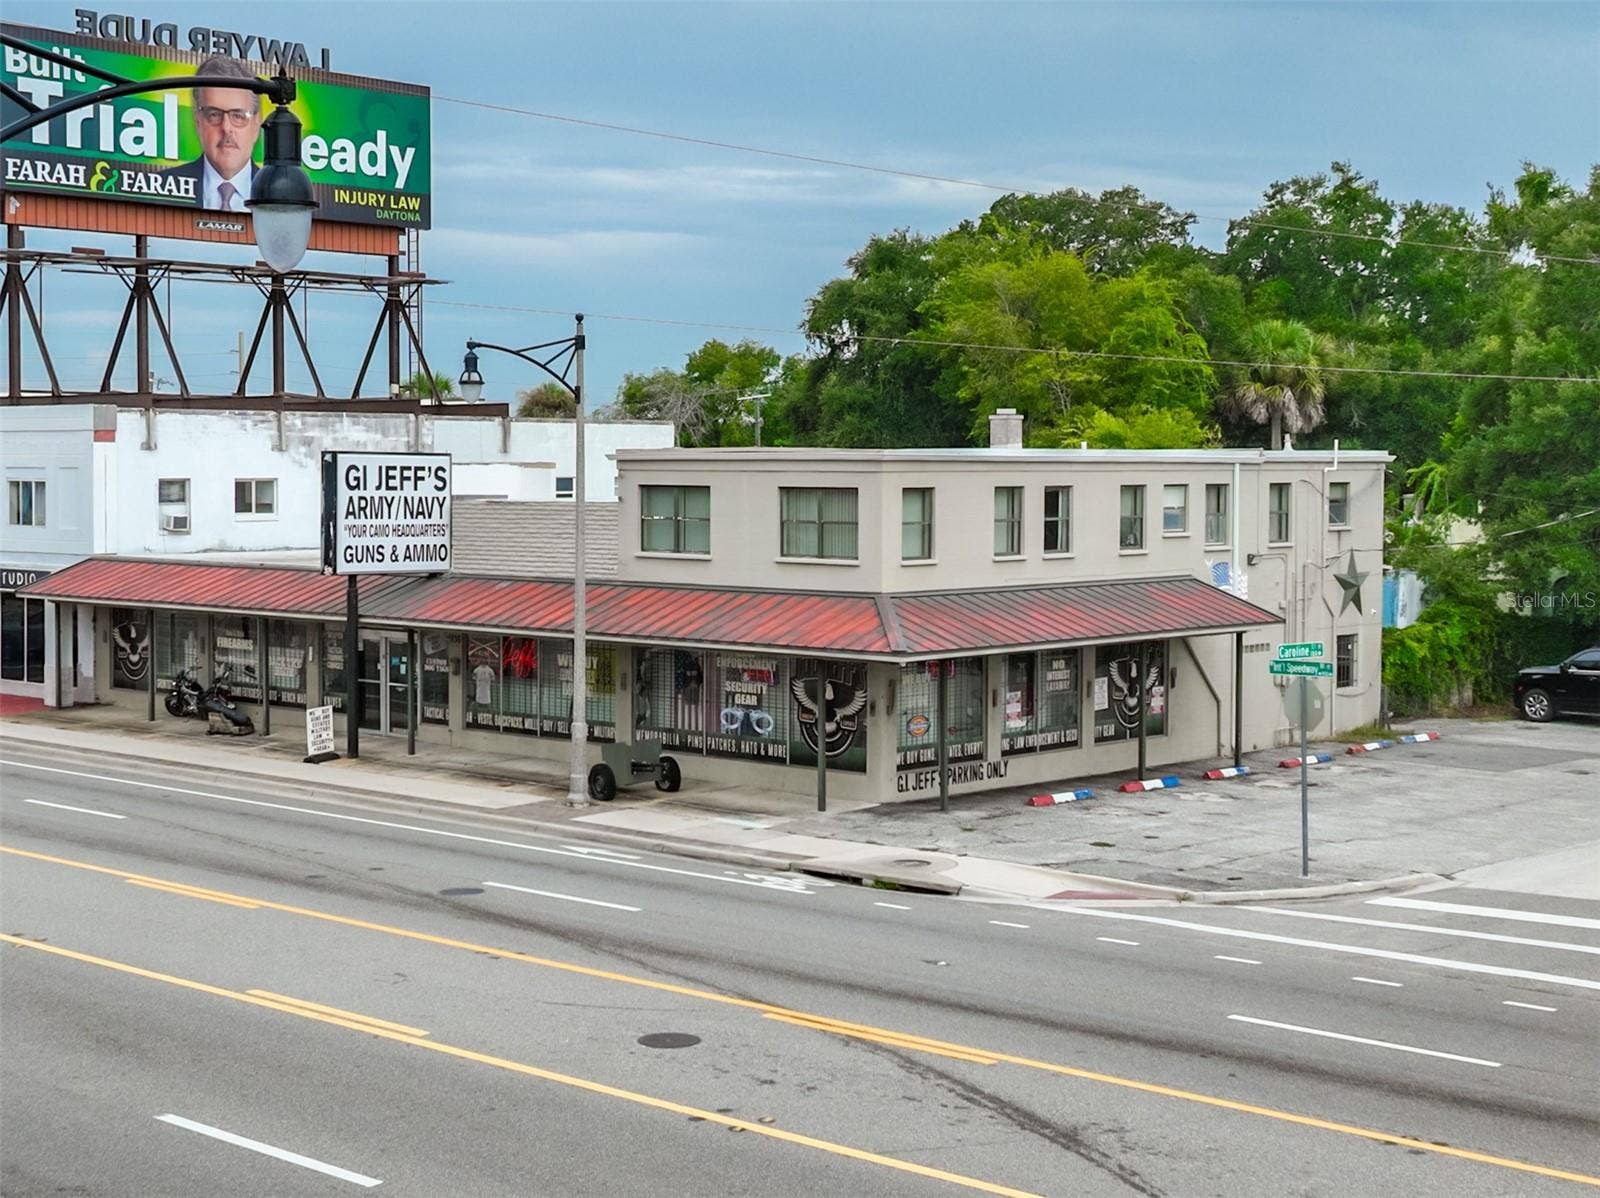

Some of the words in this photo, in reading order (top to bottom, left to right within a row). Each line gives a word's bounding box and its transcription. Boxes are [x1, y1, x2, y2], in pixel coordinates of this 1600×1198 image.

[5, 44, 87, 83] Built
[17, 76, 179, 160] Trial
[300, 129, 416, 190] eady
[5, 157, 87, 187] FARAH
[120, 169, 198, 199] FARAH
[334, 189, 386, 208] INJURY
[390, 196, 421, 211] LAW
[376, 209, 422, 222] DAYTONA
[198, 221, 243, 231] LAMAR
[344, 464, 368, 492] GI
[374, 465, 448, 492] JEFF'S
[344, 495, 447, 521] ARMY/NAVY
[368, 524, 391, 538] CAMO
[343, 544, 385, 564] GUNS
[389, 544, 400, 563] &
[403, 543, 448, 563] AMMO
[216, 636, 254, 651] FIREARMS
[1279, 646, 1310, 658] Caroline
[1052, 659, 1066, 669] NO
[1286, 663, 1318, 676] Speedway
[725, 681, 768, 695] SECURITY
[734, 693, 758, 706] GEAR
[741, 743, 758, 756] HATS
[760, 744, 766, 756] &
[768, 745, 787, 759] MORE
[947, 763, 984, 785] PARKING
[986, 760, 1009, 779] ONLY
